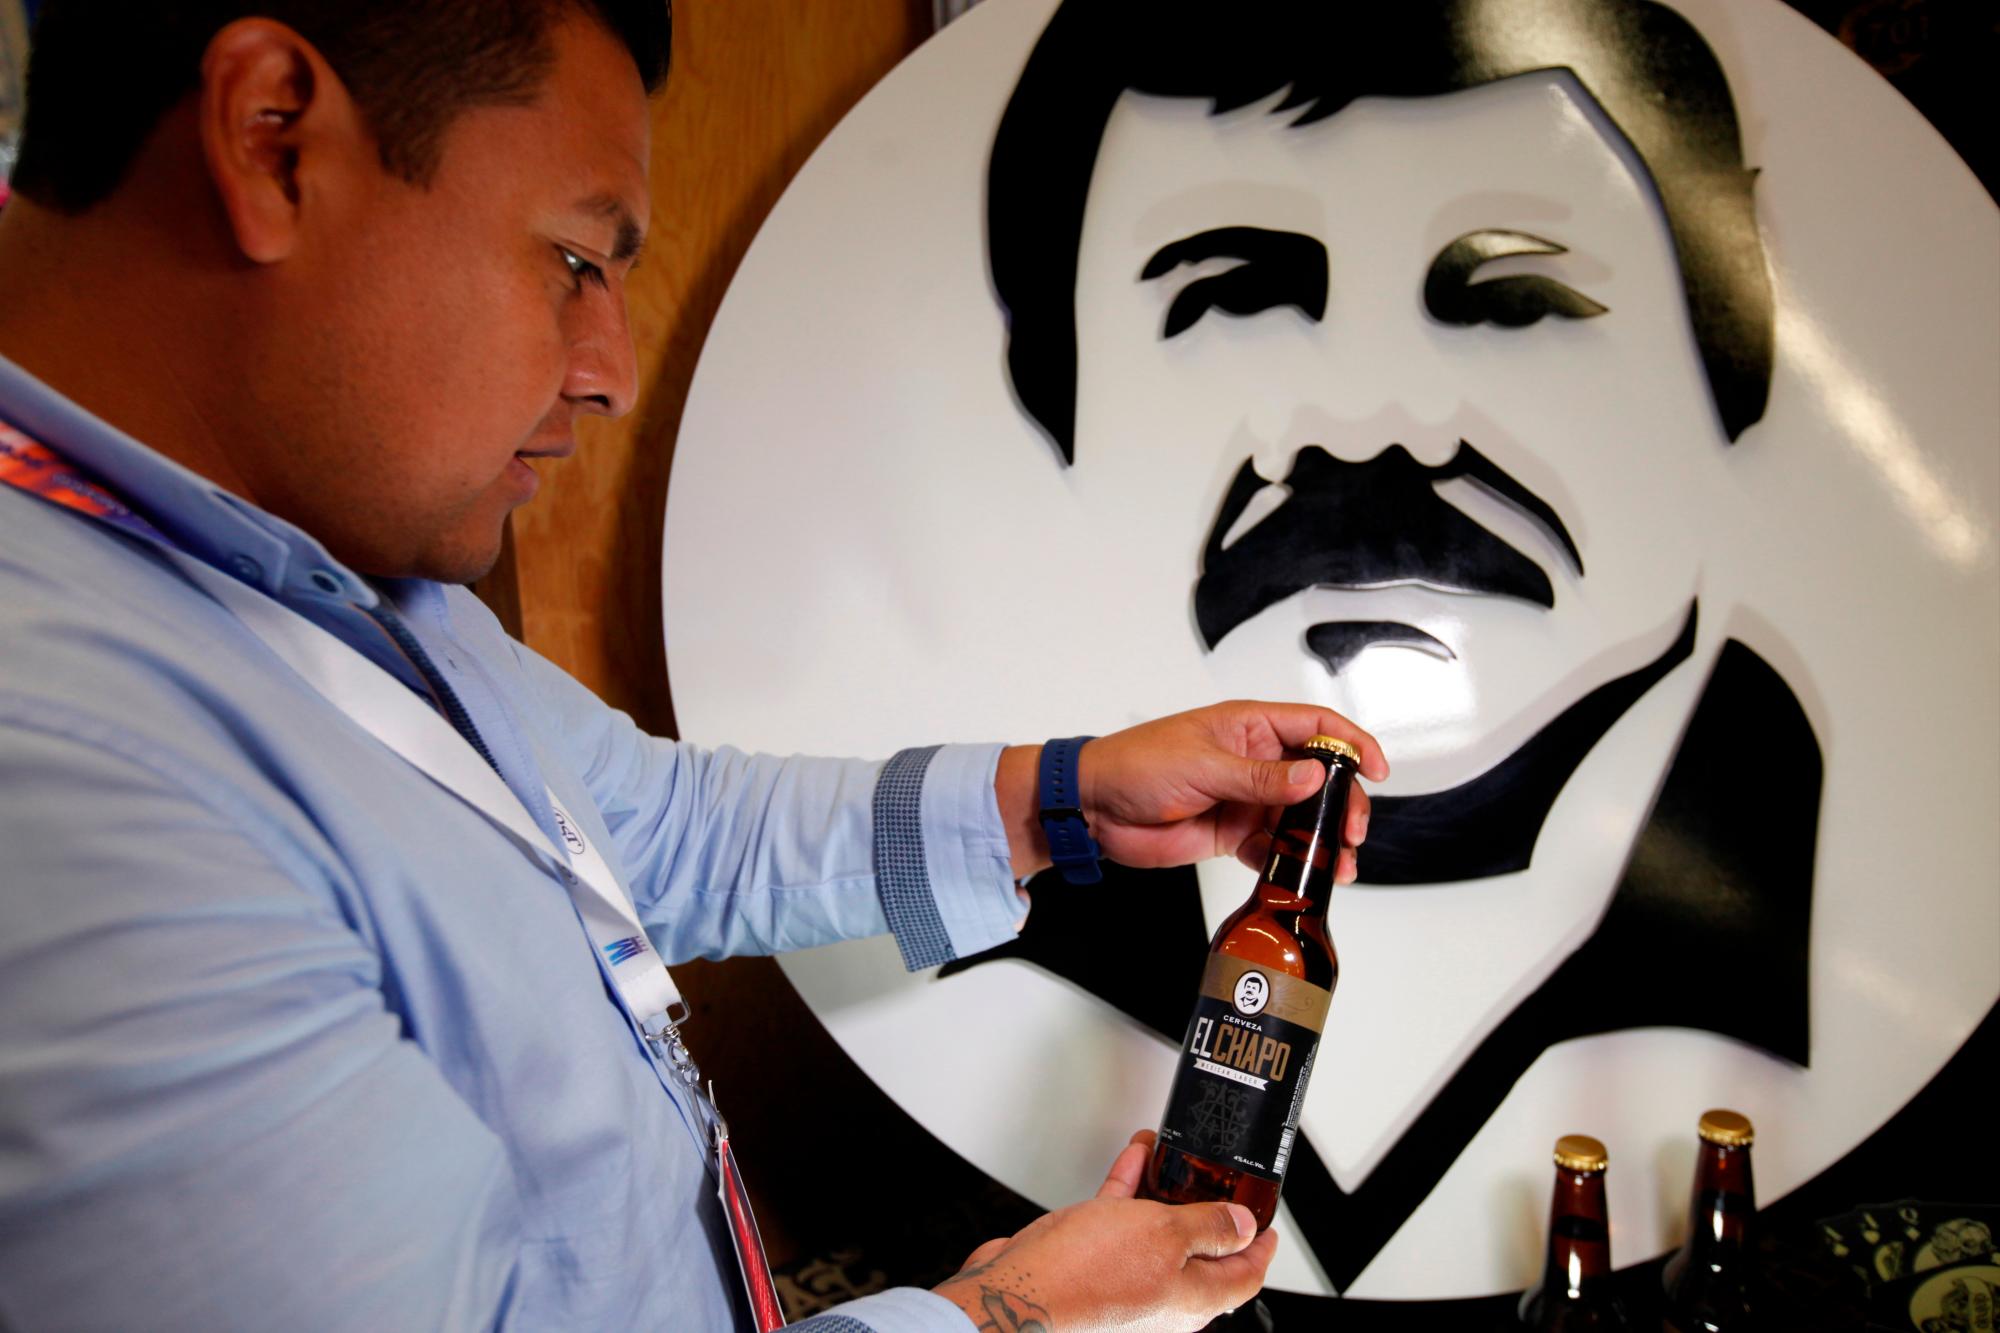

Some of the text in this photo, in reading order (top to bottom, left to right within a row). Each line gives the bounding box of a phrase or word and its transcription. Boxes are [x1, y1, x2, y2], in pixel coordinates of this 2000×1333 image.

[1223, 1015, 1261, 1031] CERVEZA
[1190, 1017, 1290, 1081] EL CHAPO
